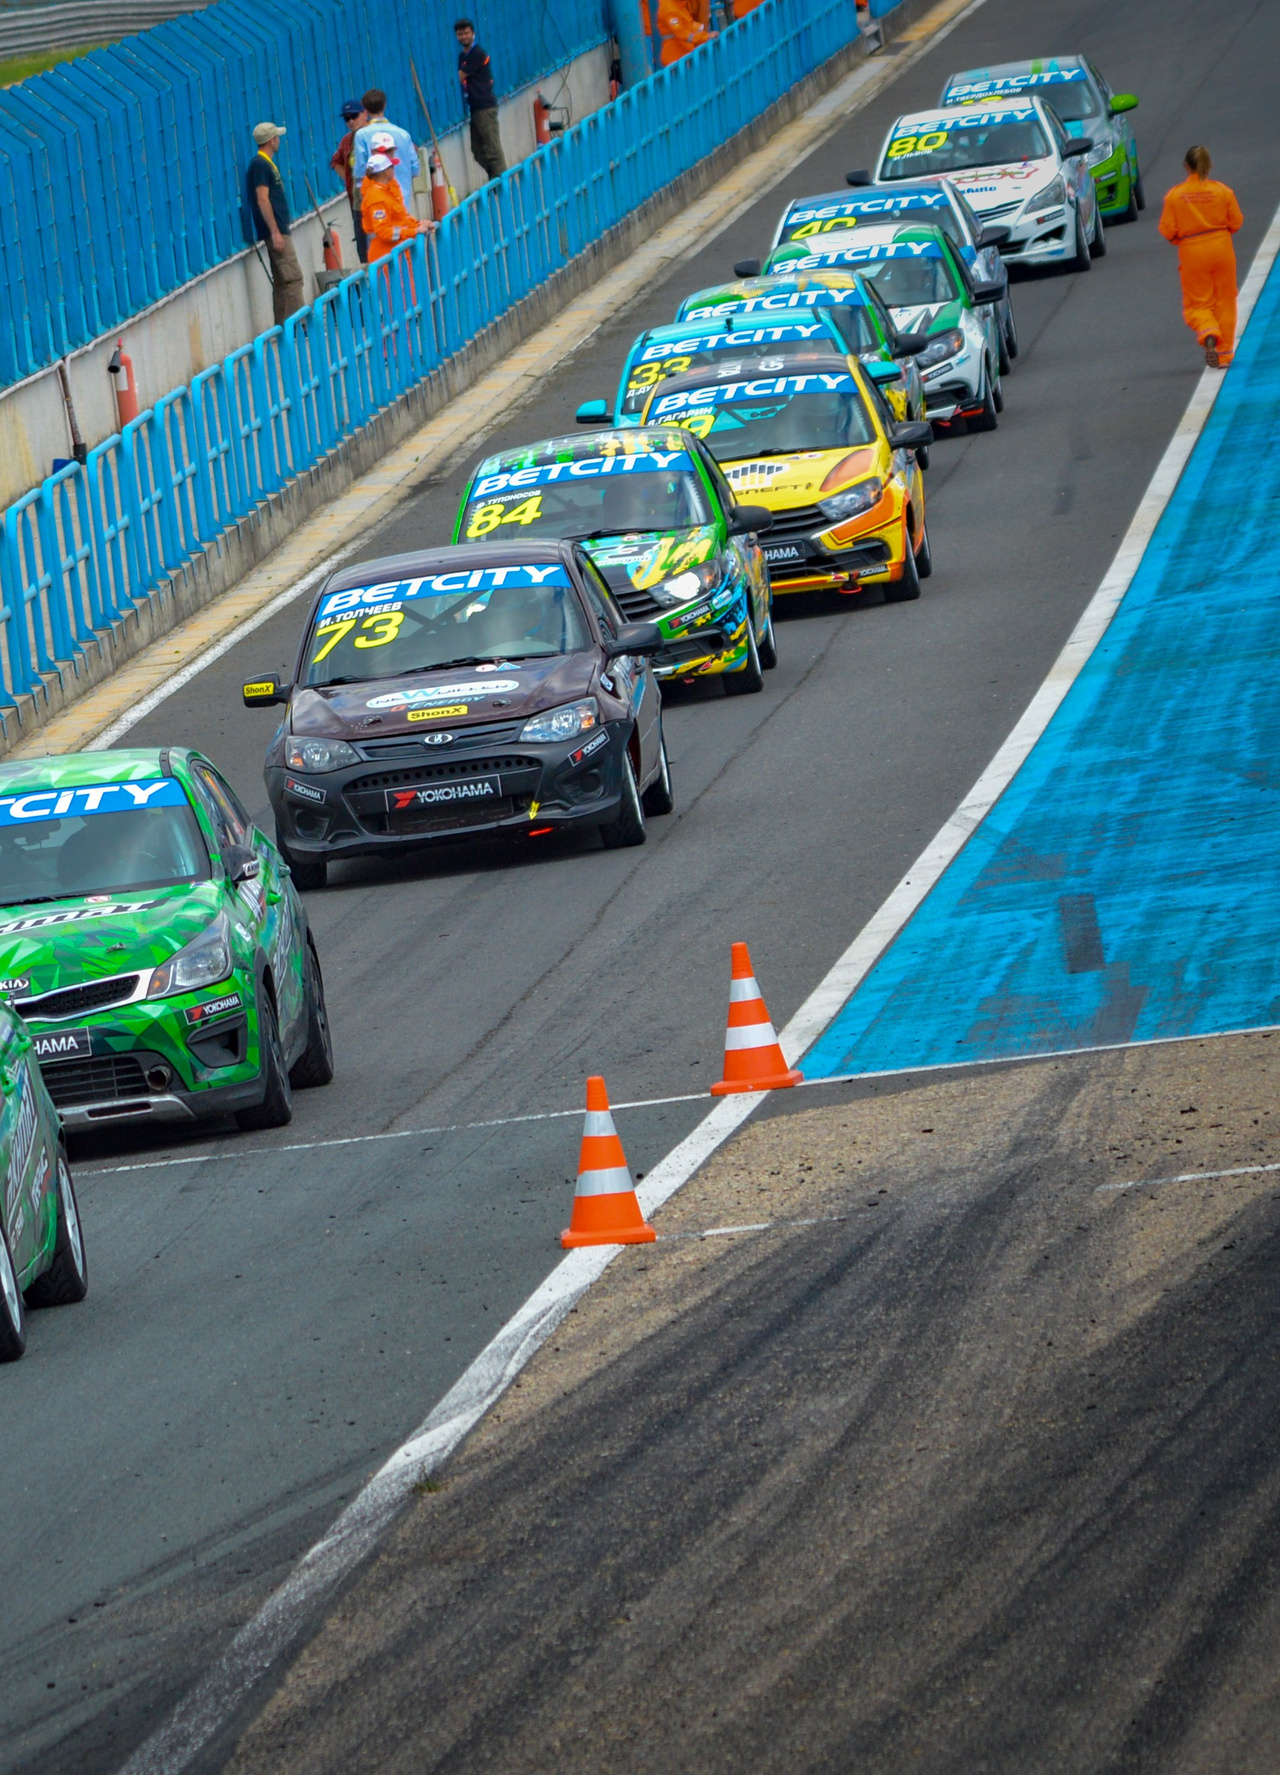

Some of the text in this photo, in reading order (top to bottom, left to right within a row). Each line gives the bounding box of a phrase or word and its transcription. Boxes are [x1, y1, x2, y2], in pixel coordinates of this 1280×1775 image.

[946, 68, 1081, 98] BETCITY
[894, 108, 1035, 139] BETCITY
[888, 131, 948, 158] 80
[788, 193, 944, 225] BETCITY
[790, 216, 857, 241] 40
[773, 242, 932, 274] BETCITY
[685, 289, 855, 322] BETCITY
[641, 324, 822, 361] BETCITY
[628, 356, 692, 390] 33
[626, 385, 655, 399] Д.ДУ
[654, 373, 849, 415] BETCITY
[661, 414, 715, 440] 9
[474, 451, 682, 498] BETCITY
[466, 495, 543, 538] 84
[764, 547, 799, 560] HAMA
[322, 564, 561, 616] BETCITY
[319, 601, 403, 629] И.ТОЛЧЕЕВ
[680, 605, 709, 623] YOKOHAMA
[313, 611, 405, 664] 73
[244, 684, 273, 696] ShonX
[410, 706, 464, 720] ShonX
[582, 733, 607, 755] YOKOHAMA
[293, 784, 322, 800] YOKOHAMA
[417, 781, 494, 804] YOKOHAMA
[203, 994, 240, 1016] YOKOHAMA
[33, 1036, 79, 1055] HAMA
